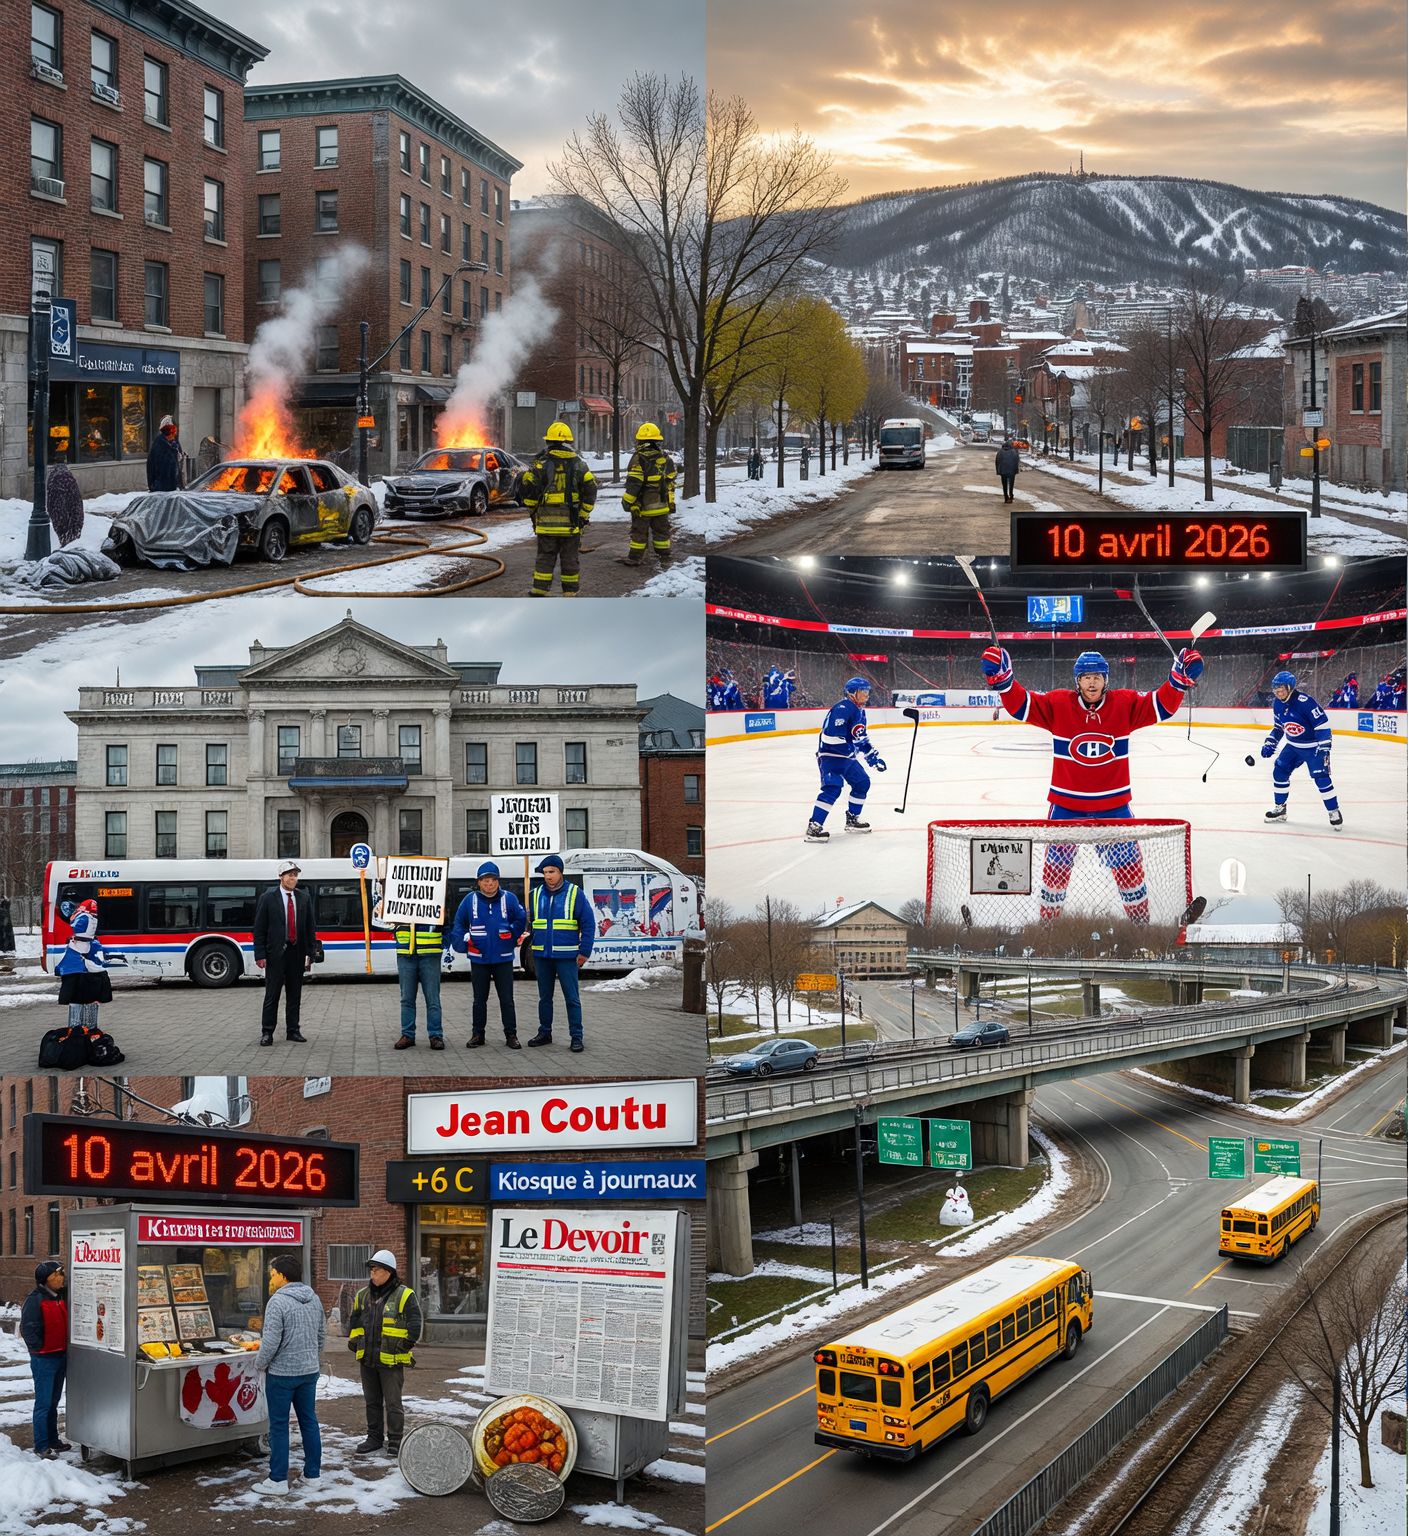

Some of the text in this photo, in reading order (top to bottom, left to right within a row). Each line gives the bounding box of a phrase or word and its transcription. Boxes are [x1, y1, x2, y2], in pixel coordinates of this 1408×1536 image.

[1048, 524, 1270, 558] 10 avril 2026
[436, 1096, 667, 1138] Jean Coutu
[63, 1134, 326, 1191] 10 avril 2026
[411, 1166, 474, 1193] +6 C
[498, 1170, 697, 1195] Kiosque à journaux
[499, 1217, 650, 1255] Le Devoir
